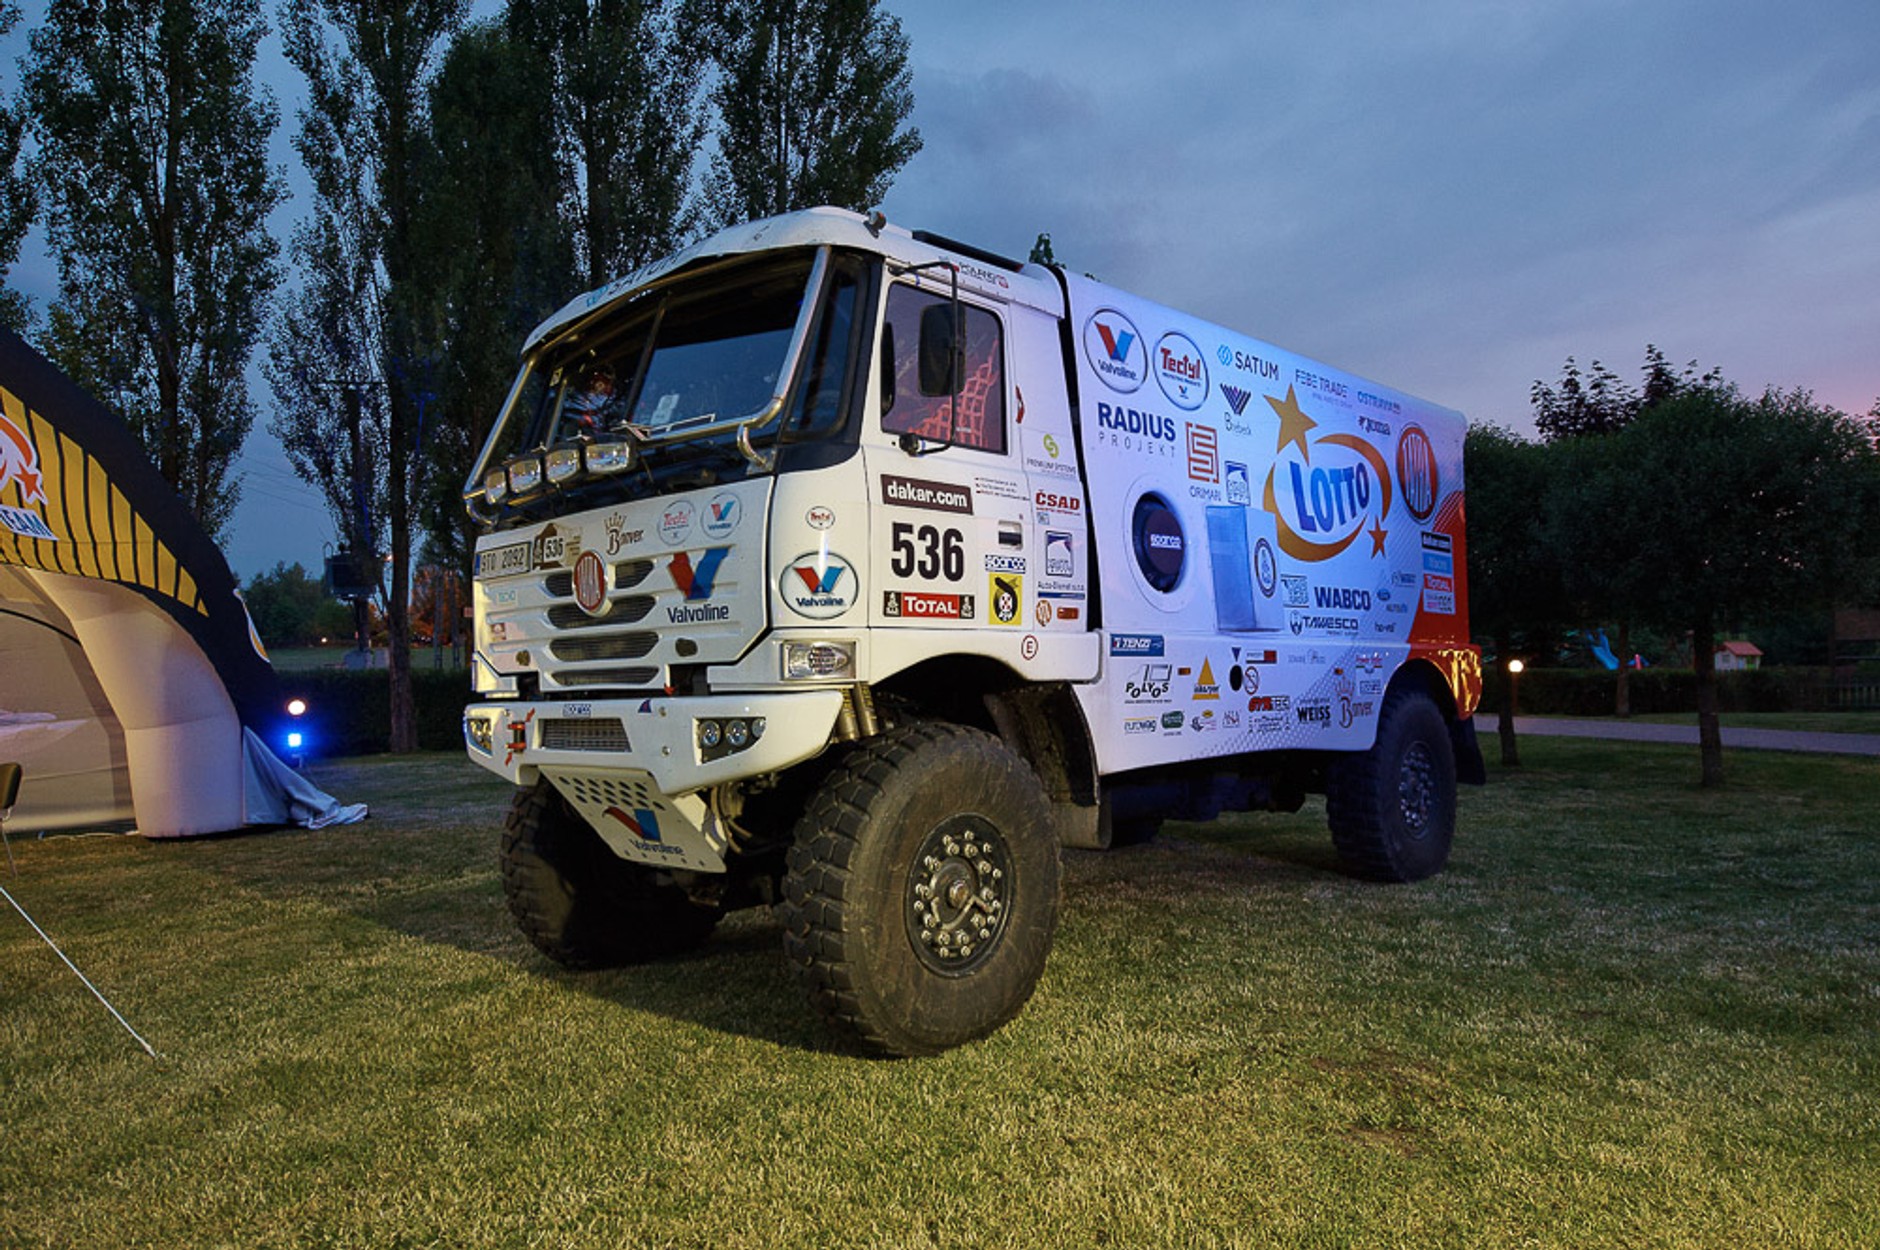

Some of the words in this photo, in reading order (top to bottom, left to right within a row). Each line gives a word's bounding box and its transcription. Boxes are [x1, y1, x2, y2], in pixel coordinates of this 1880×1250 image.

[1161, 346, 1201, 380] Tectyl
[1235, 351, 1279, 381] SATUM
[1098, 402, 1176, 442] RADIUS
[1099, 431, 1175, 458] PROJEKT
[887, 480, 967, 508] dakar.com
[1035, 488, 1081, 511] ČSAD
[1290, 460, 1370, 533] LOTTO
[891, 521, 965, 582] 536
[795, 597, 845, 607] Valvoline
[1314, 586, 1371, 612] WABCO
[667, 604, 729, 624] Valvoline
[1126, 682, 1169, 699] POLYOS
[1297, 706, 1331, 722] WEISS
